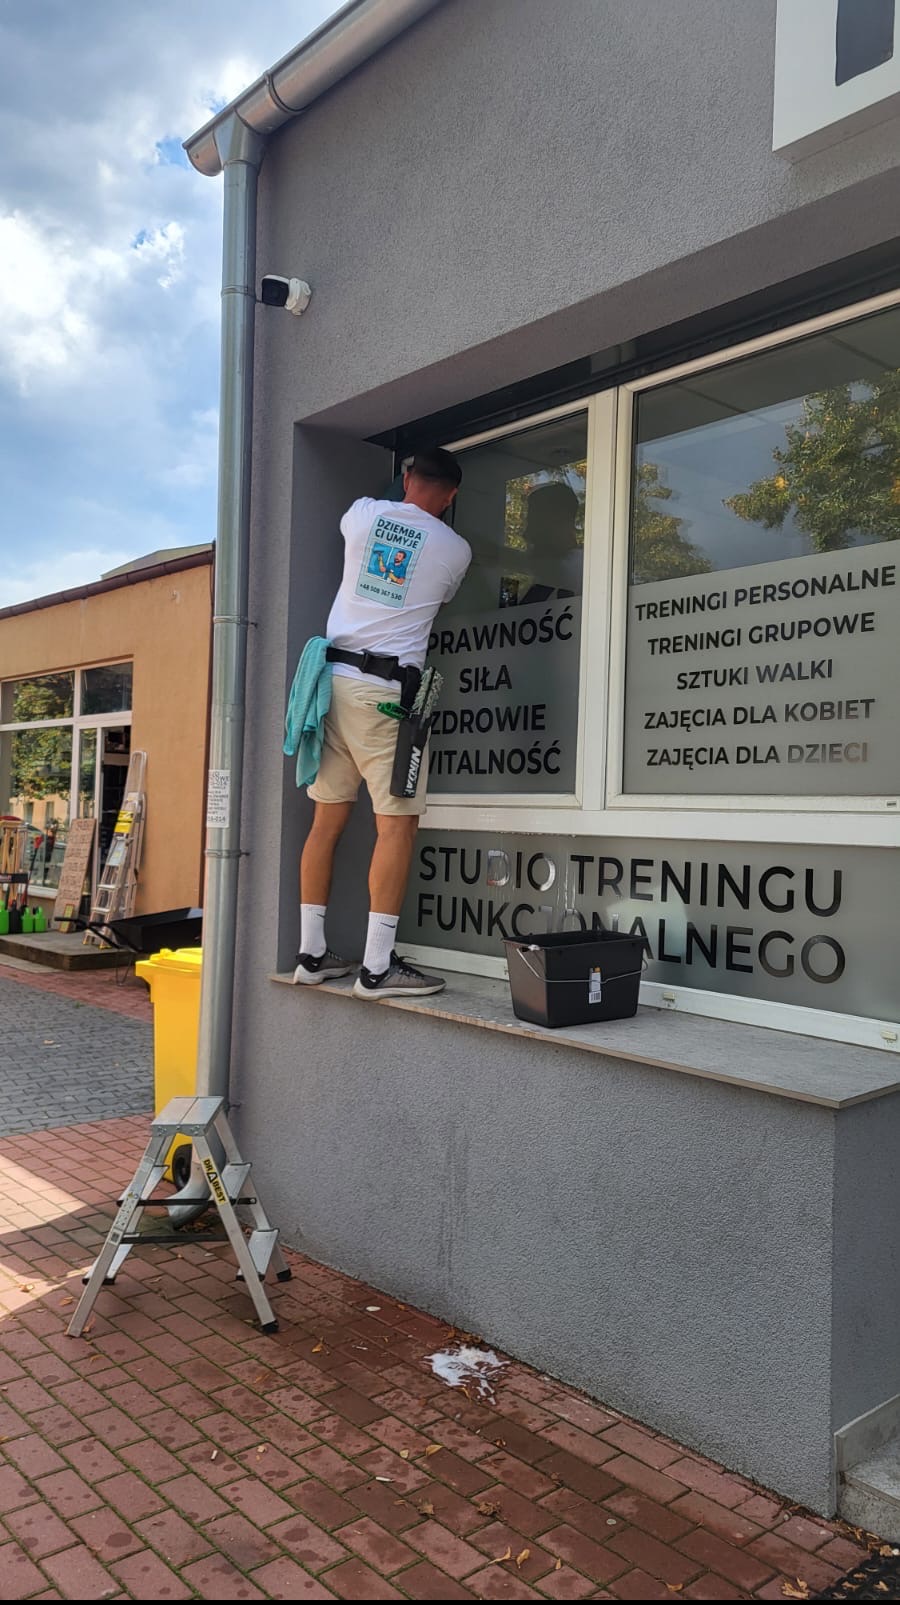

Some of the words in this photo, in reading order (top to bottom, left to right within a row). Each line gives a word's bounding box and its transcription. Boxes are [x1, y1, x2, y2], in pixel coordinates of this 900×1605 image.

[375, 528, 384, 538] CI
[386, 534, 419, 549] UMYJE
[377, 519, 421, 540] DZIEMBA
[635, 591, 727, 621] TRENINGI
[734, 565, 896, 607] PERSONALNE
[426, 606, 573, 656] PRAWNOŚĆ
[648, 628, 741, 656] TRENINGI
[749, 612, 875, 644] GRUPOWE
[459, 664, 513, 693] SIŁA
[676, 666, 748, 690] SZTUKI
[756, 659, 833, 683] WALKI
[431, 703, 546, 735] ZDROWIE
[644, 708, 726, 732] ZAJĘCIA
[733, 705, 777, 725] DLA
[784, 699, 875, 723] KOBIET
[406, 746, 421, 789] NINJA
[646, 747, 729, 770] ZAJĘCIA
[736, 745, 780, 765] DLA
[787, 742, 868, 764] DZIECI
[419, 846, 556, 892] STUDIO
[570, 854, 842, 917] TRENINGU
[203, 1159, 226, 1202] DRABEST
